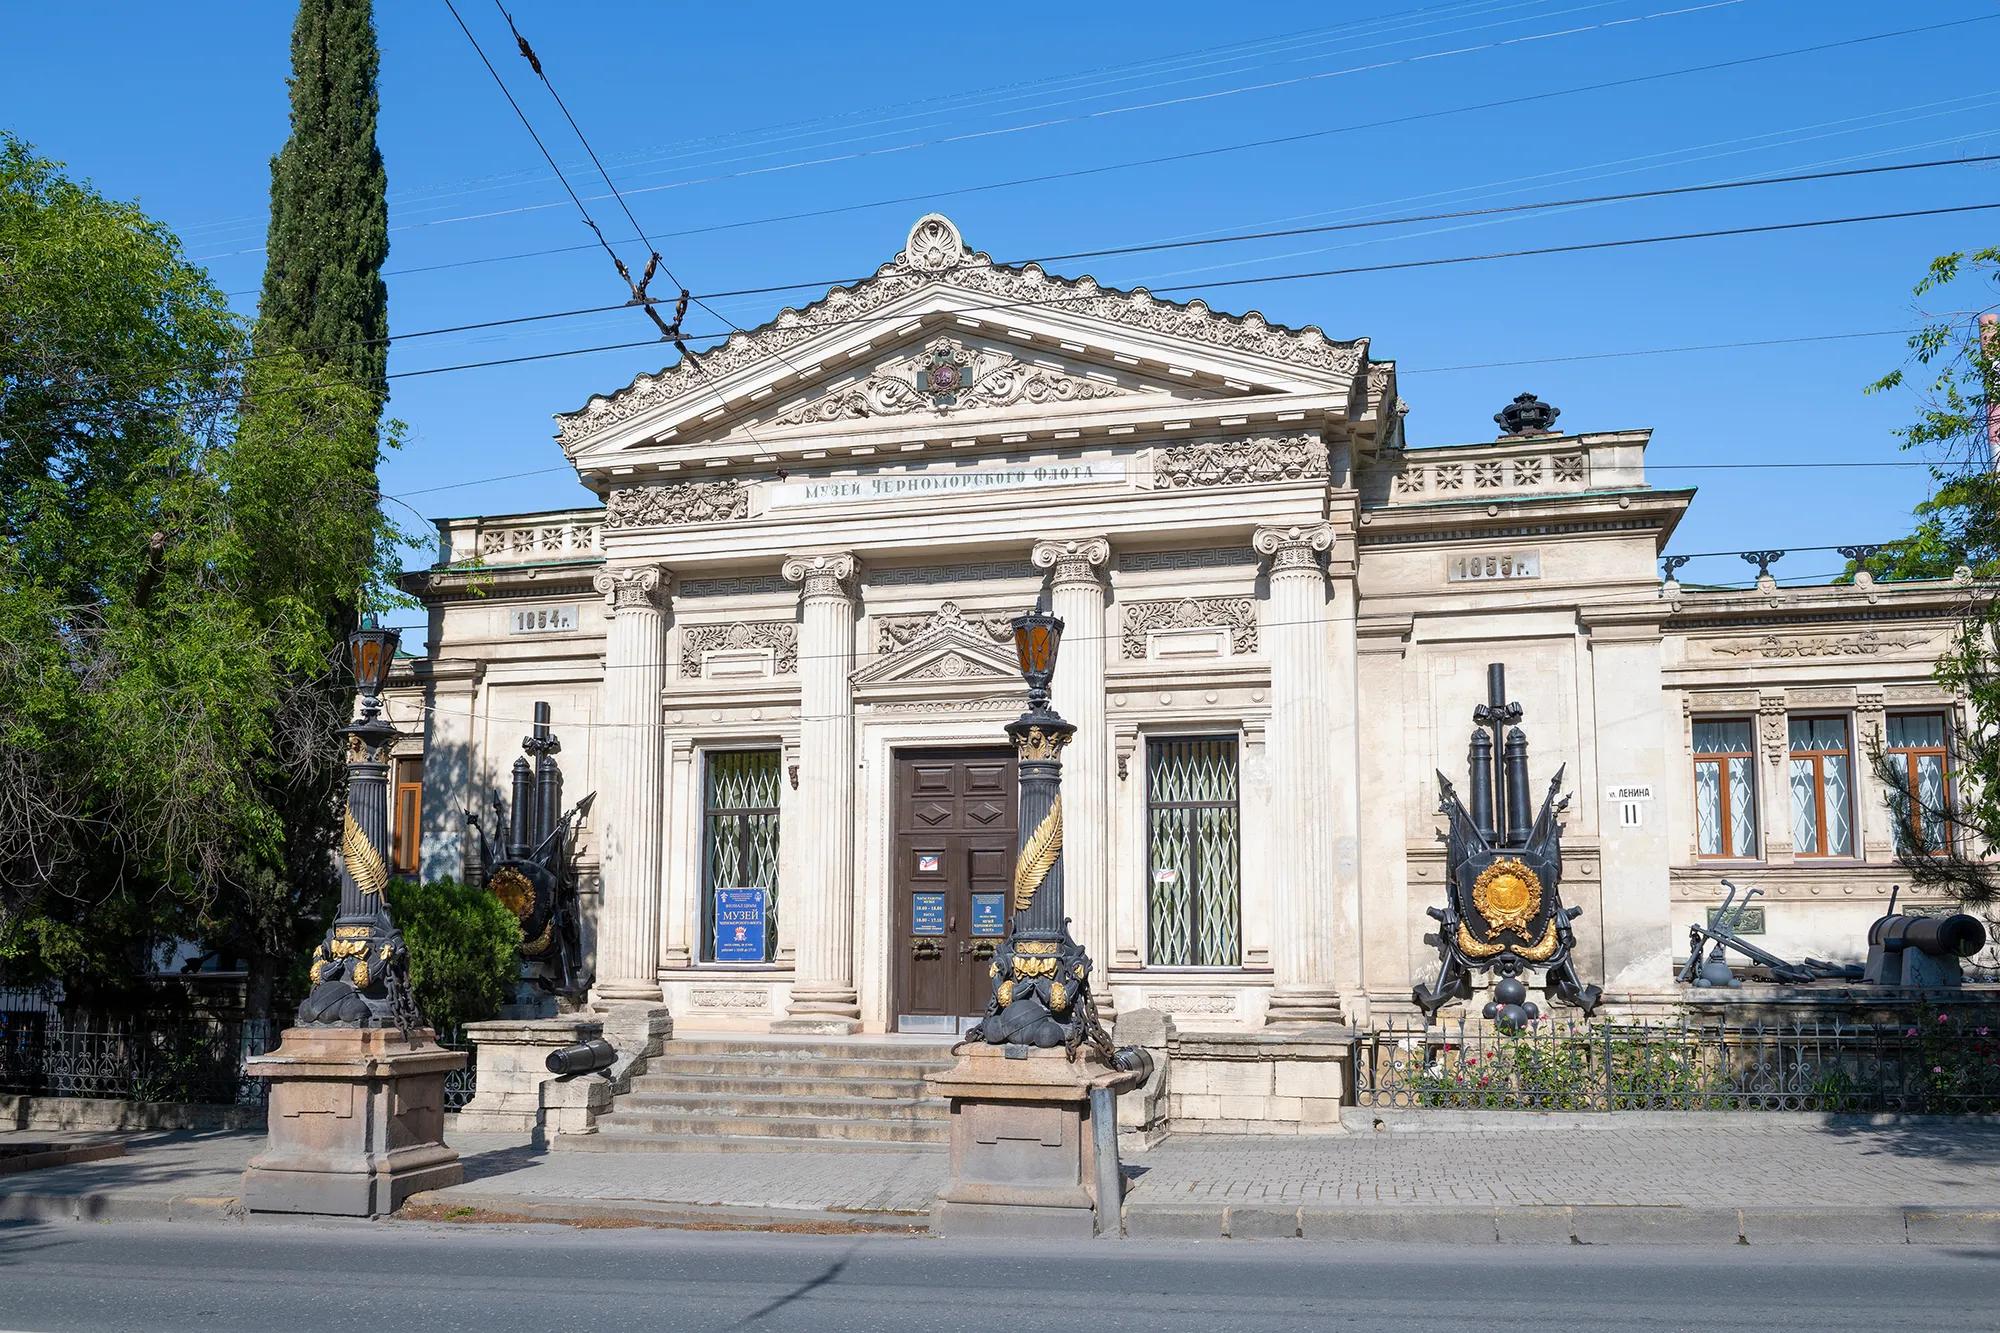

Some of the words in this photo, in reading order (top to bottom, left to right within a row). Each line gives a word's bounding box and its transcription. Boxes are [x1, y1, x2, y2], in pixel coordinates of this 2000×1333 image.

[805, 481, 861, 499] МУЗЕЙ
[871, 470, 1026, 496] ЧЕРНОМОРСКОГО
[1033, 466, 1094, 482] ФЛОТА
[1618, 788, 1650, 798] ЛЕНИНА
[1624, 804, 1637, 824] 11
[723, 909, 759, 921] МУЗЕЙ
